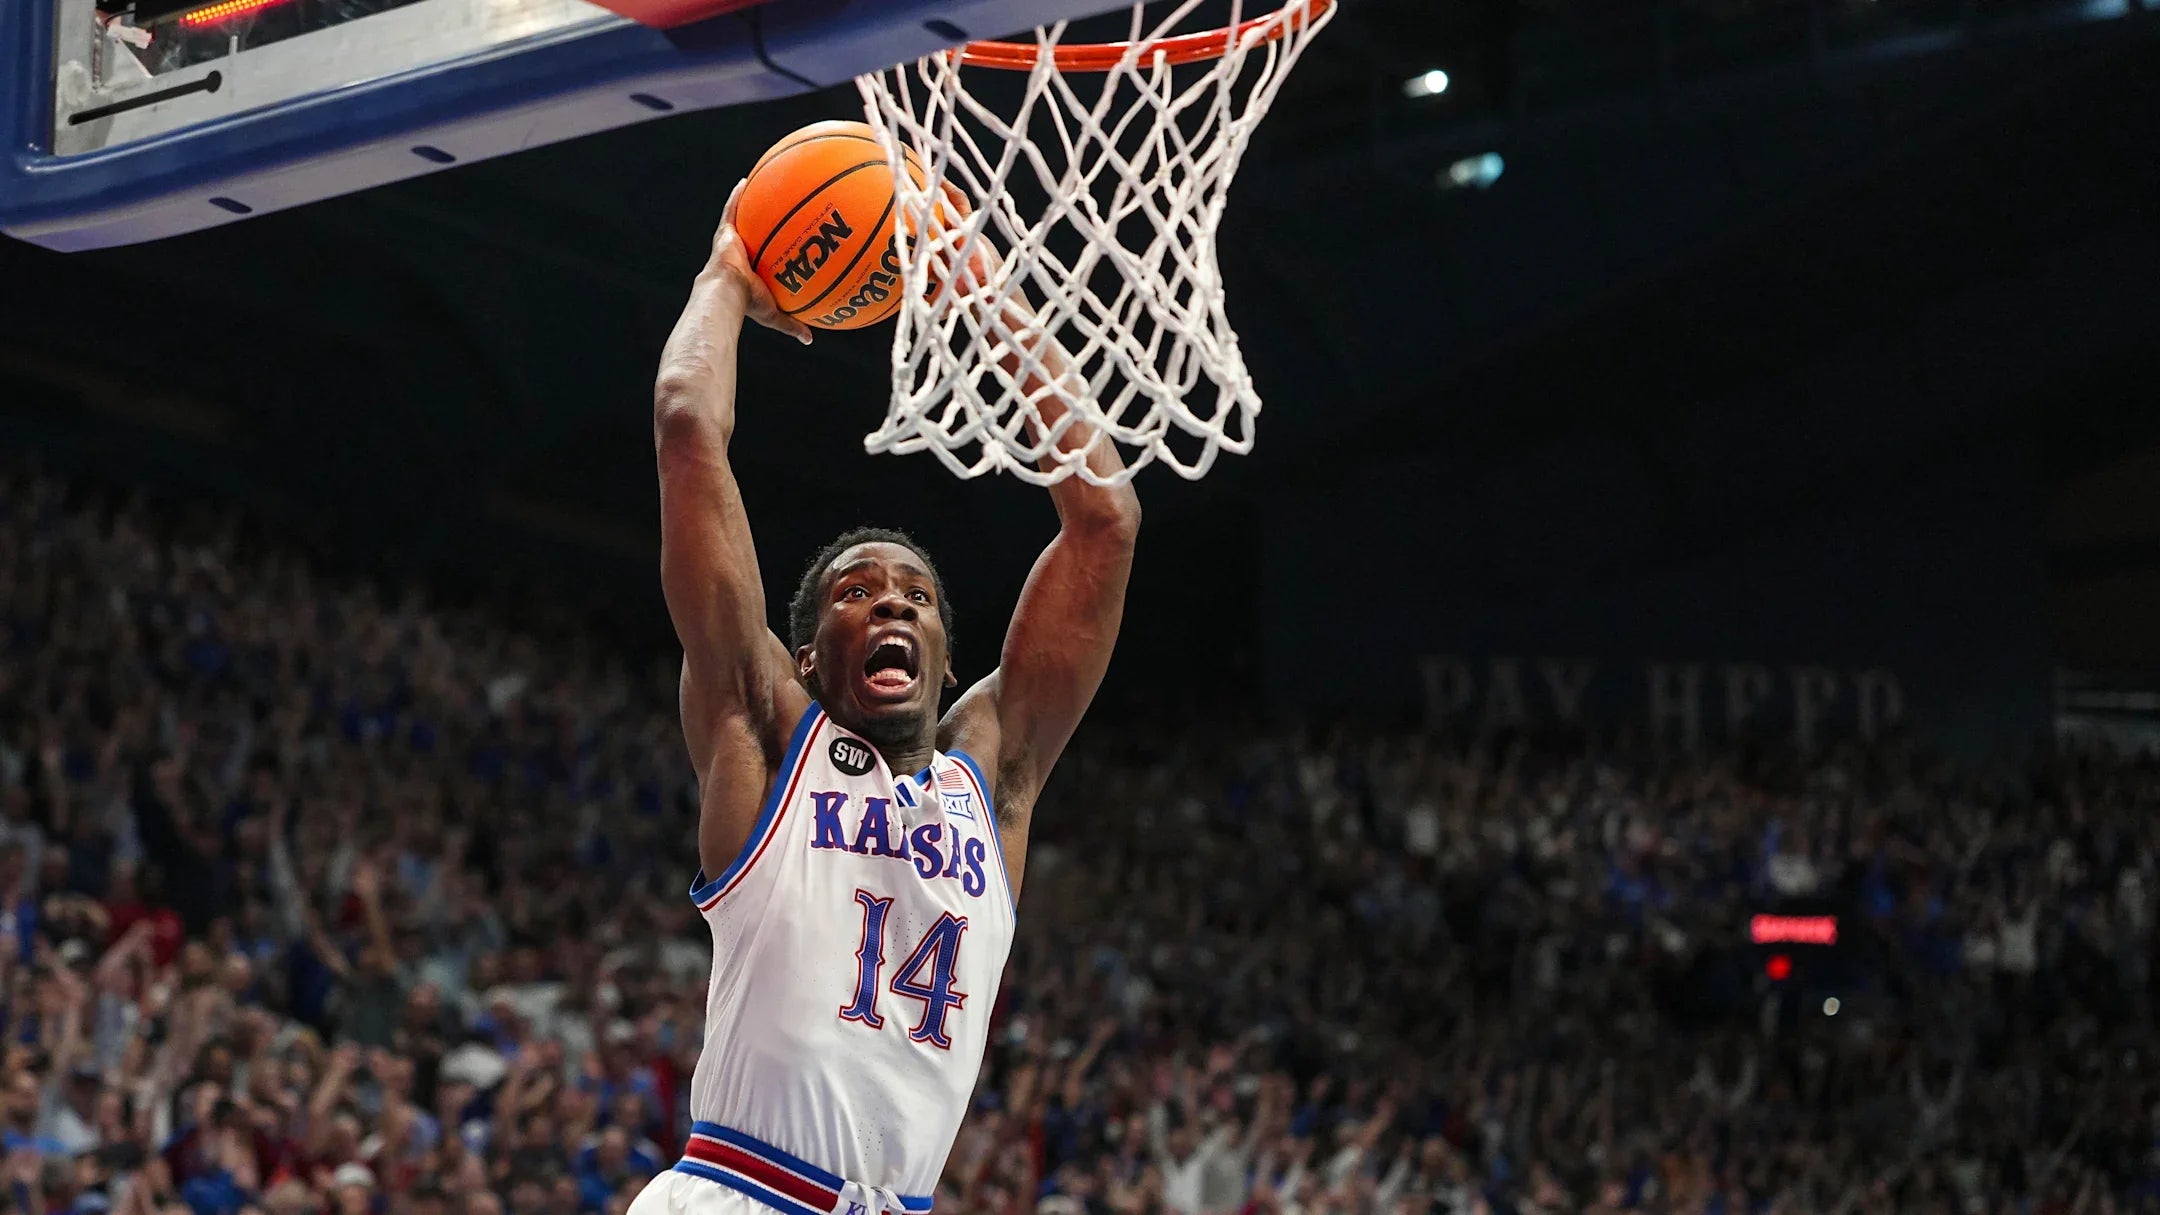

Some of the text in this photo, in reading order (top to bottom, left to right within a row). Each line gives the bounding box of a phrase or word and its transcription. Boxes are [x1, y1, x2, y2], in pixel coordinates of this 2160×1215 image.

[774, 208, 853, 294] NCAA
[833, 741, 870, 770] SW
[839, 888, 968, 1050] 14
